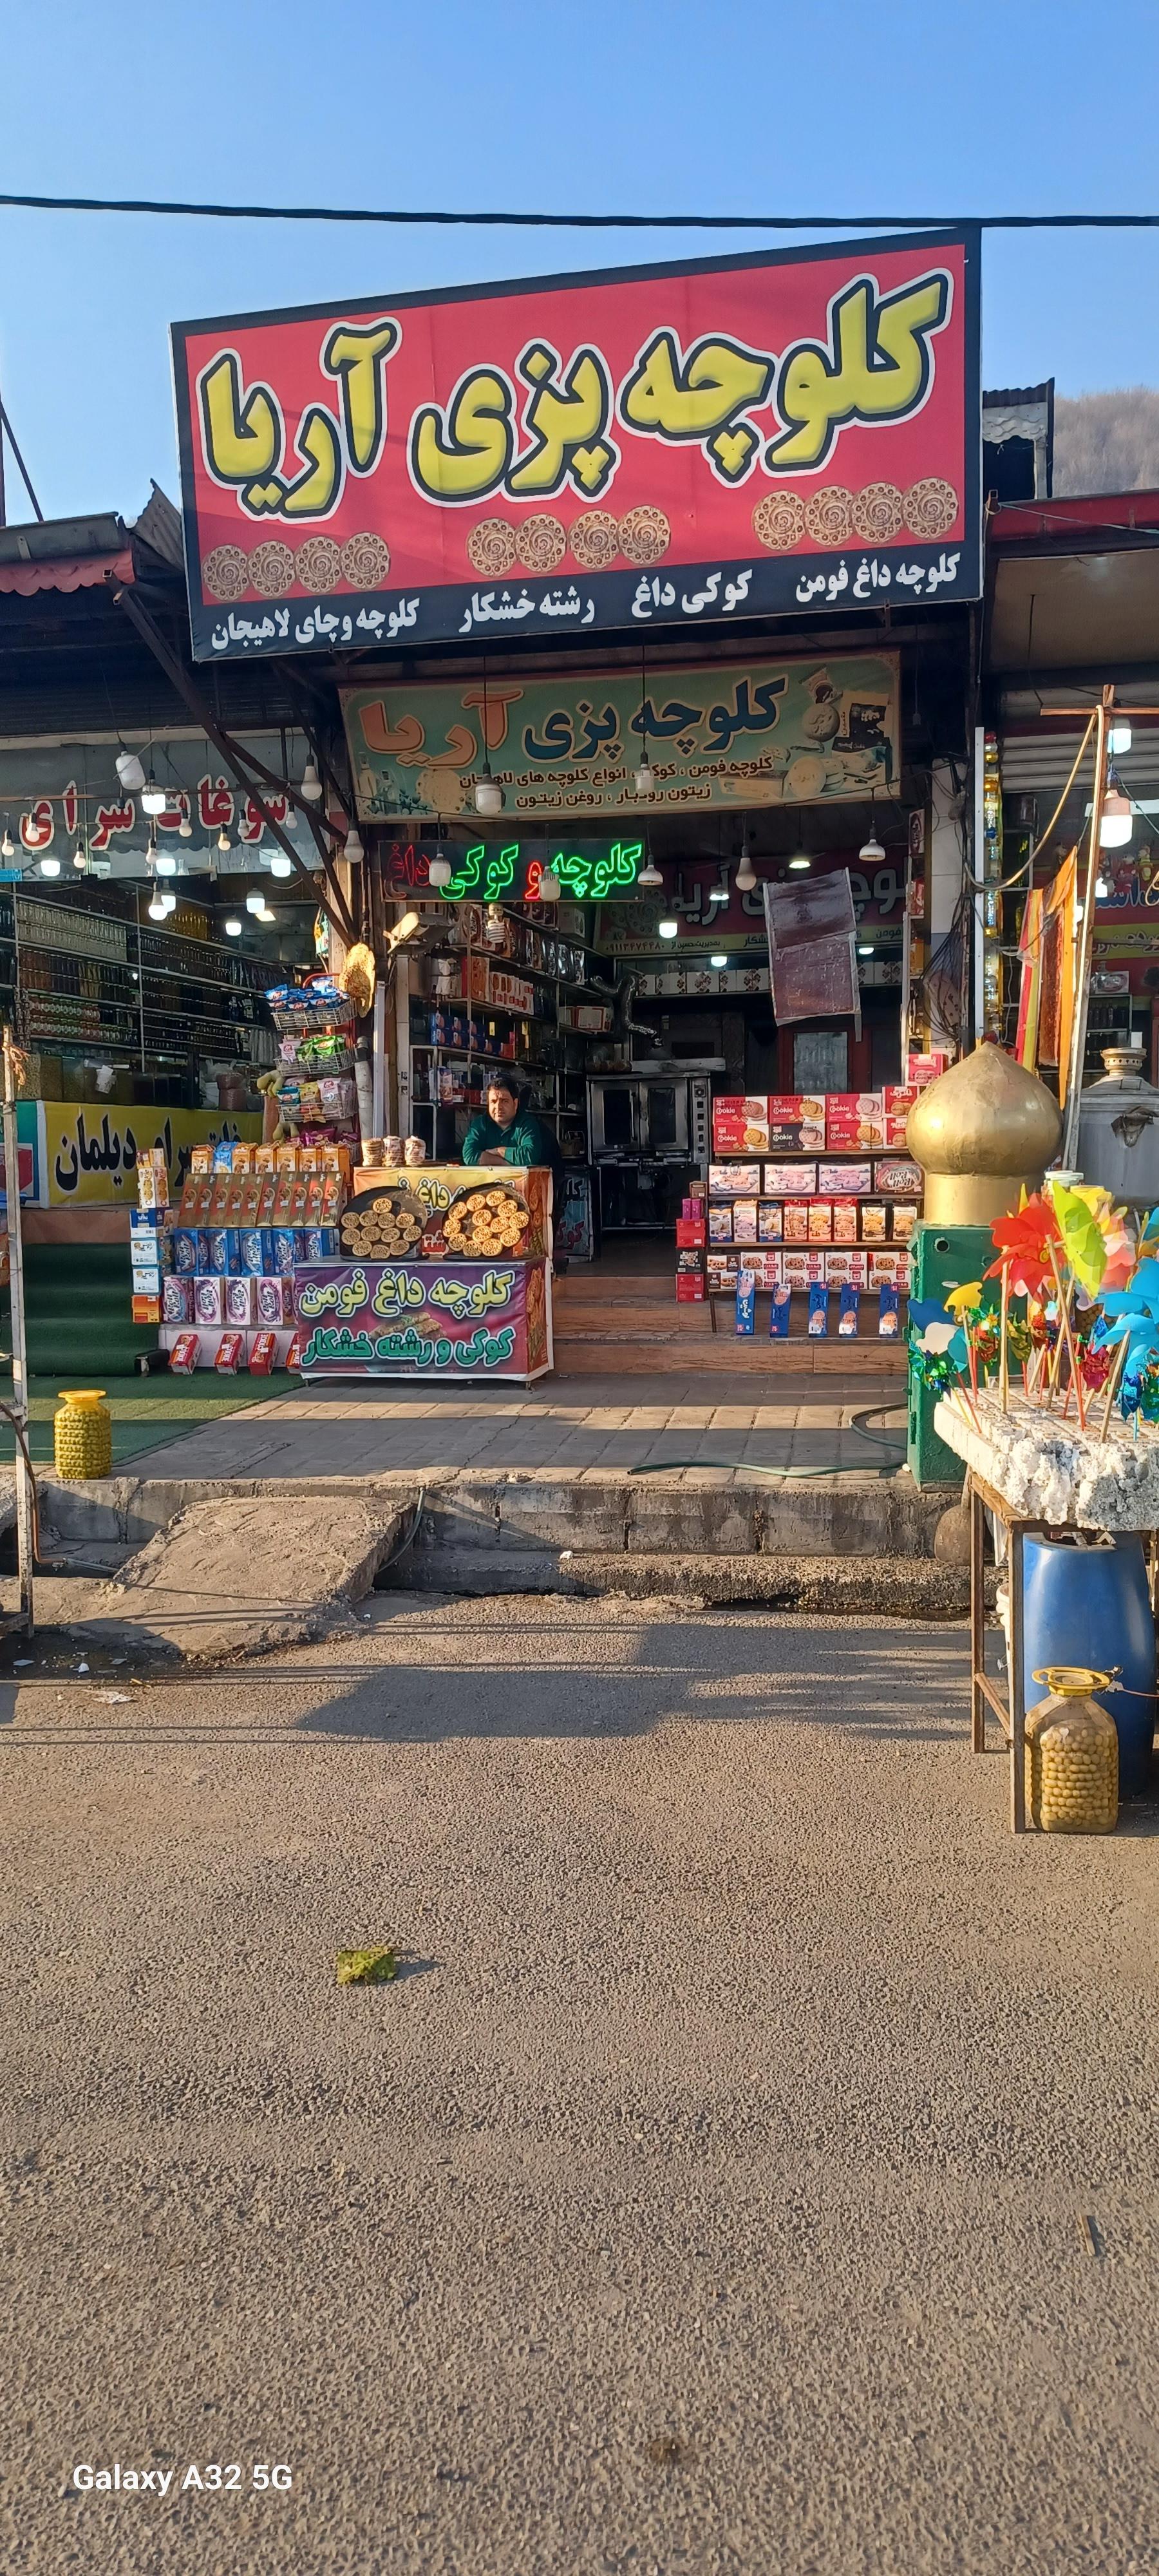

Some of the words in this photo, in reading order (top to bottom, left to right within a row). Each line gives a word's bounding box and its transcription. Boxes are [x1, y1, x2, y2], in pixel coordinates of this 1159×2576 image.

[619, 268, 956, 487] کلوچه
[197, 317, 402, 524] آریا
[410, 338, 619, 507] پزی
[681, 569, 752, 613] کوکی
[796, 560, 848, 602] فومن
[853, 558, 891, 598] داغ
[896, 553, 961, 594] کلوچه
[458, 589, 536, 632] خشکار
[539, 585, 595, 623] رشته
[631, 575, 675, 618] داغ
[212, 608, 290, 650] لاهیجان
[356, 598, 419, 639] کلوچه
[359, 688, 524, 768] آریا
[523, 699, 625, 763] پزی
[628, 674, 789, 755] کلوچه
[516, 771, 545, 786] های
[547, 768, 589, 787] کلوچه
[592, 767, 626, 786] انواع
[652, 762, 676, 780] کوک
[689, 759, 726, 777] فومن
[730, 756, 772, 777] کلوچه
[516, 791, 561, 808] زیتون
[566, 790, 603, 806] روغن
[668, 784, 711, 800] زیتون
[384, 844, 432, 900] داغ
[439, 844, 518, 900] کوکی
[552, 842, 642, 898] کلوچه
[55, 1113, 137, 1191] دیلمان
[299, 1269, 368, 1317] فومن
[373, 1269, 424, 1316] داغ
[429, 1269, 515, 1319] کلوچه
[301, 1327, 375, 1366] خشکار
[376, 1329, 435, 1367] رشته
[436, 1338, 453, 1366] و
[454, 1327, 515, 1367] کوکی
